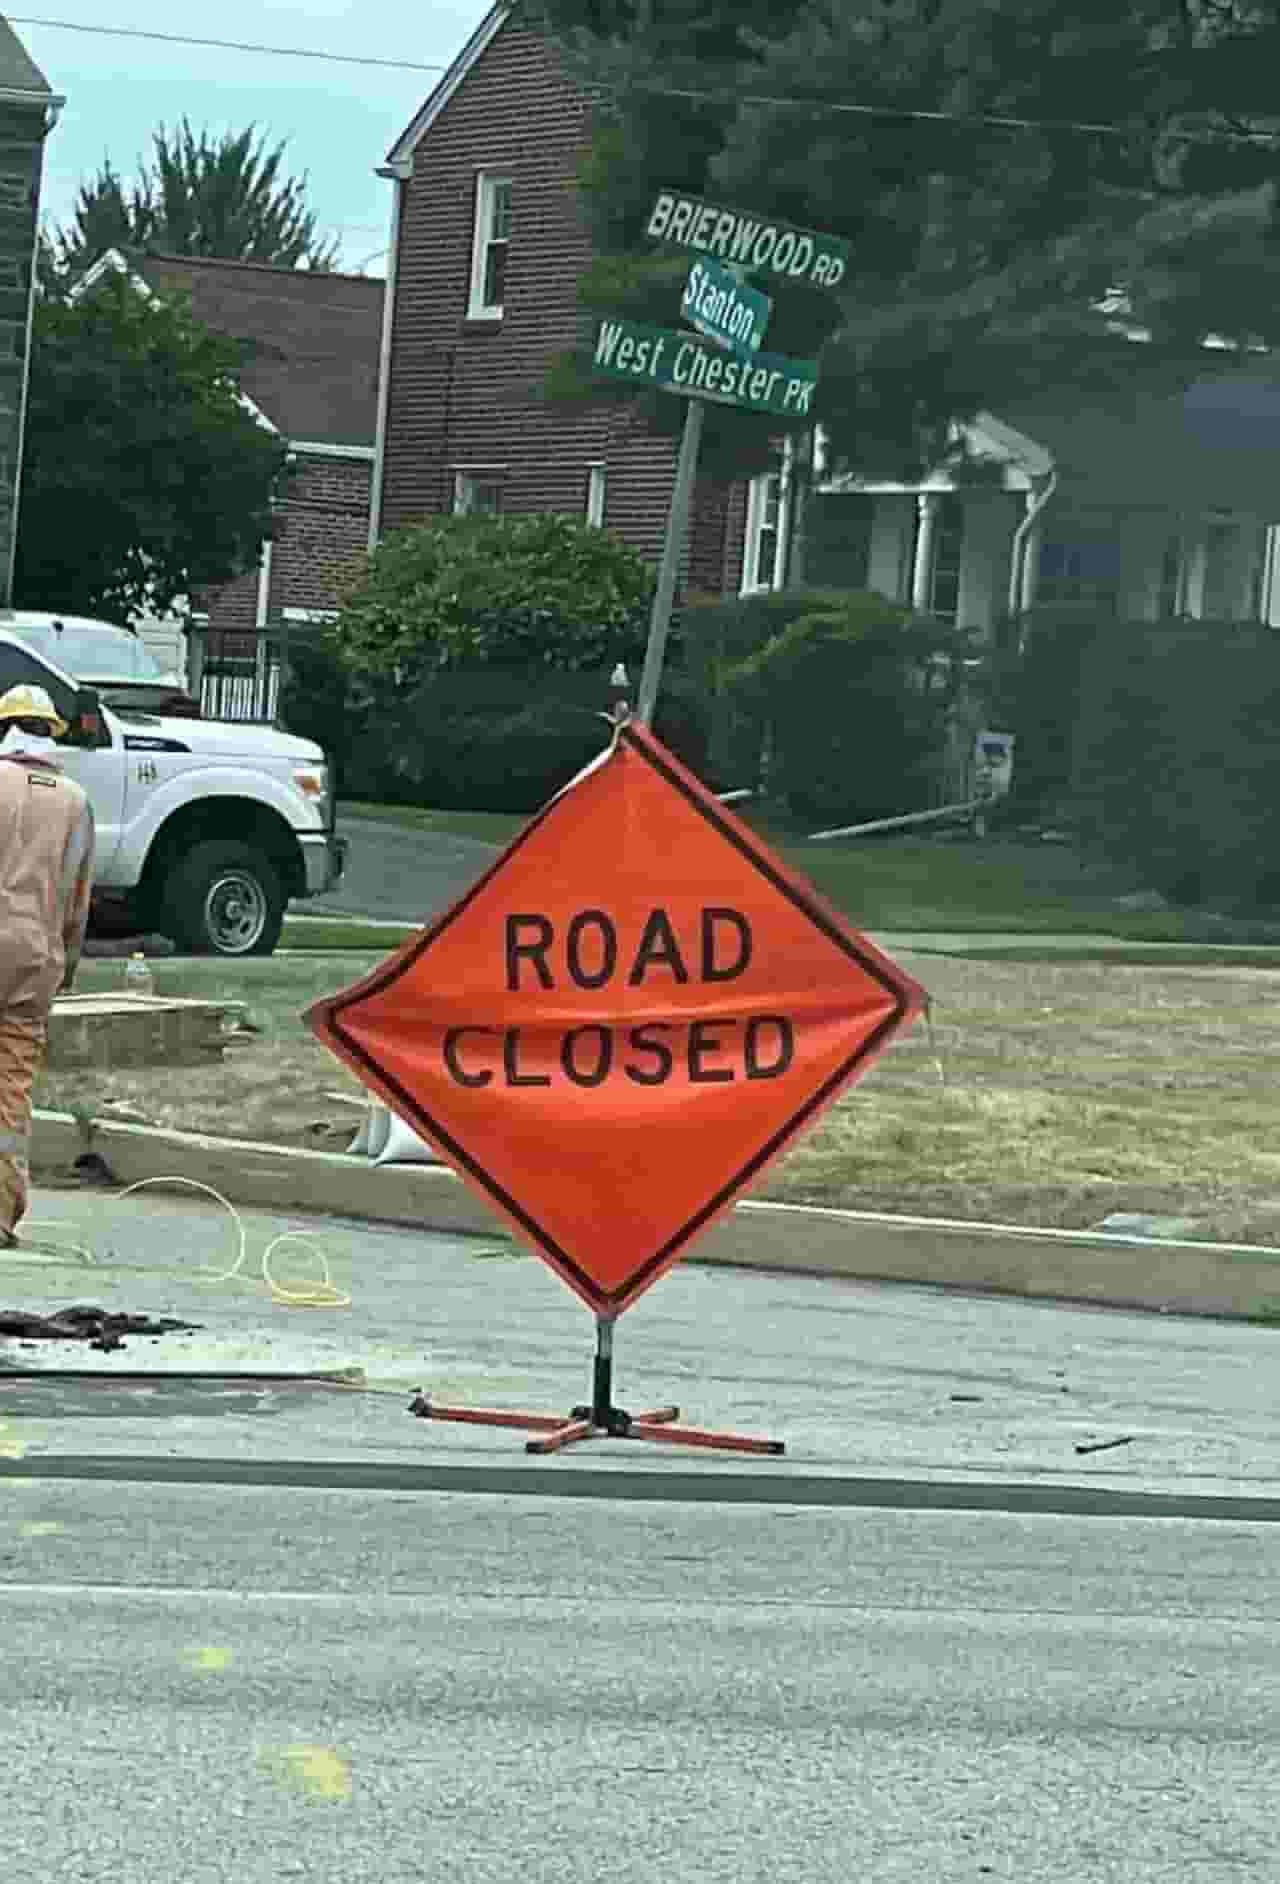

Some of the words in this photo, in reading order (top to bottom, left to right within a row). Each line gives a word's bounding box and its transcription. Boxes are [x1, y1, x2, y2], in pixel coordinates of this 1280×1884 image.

[647, 195, 813, 276] BRIERWOOD
[810, 252, 845, 286] RD
[684, 263, 755, 345] Stanton
[594, 320, 664, 376] West
[672, 343, 782, 401] Chester
[782, 378, 816, 413] PK
[504, 907, 753, 992] ROAD
[442, 1014, 795, 1089] CLOSED
